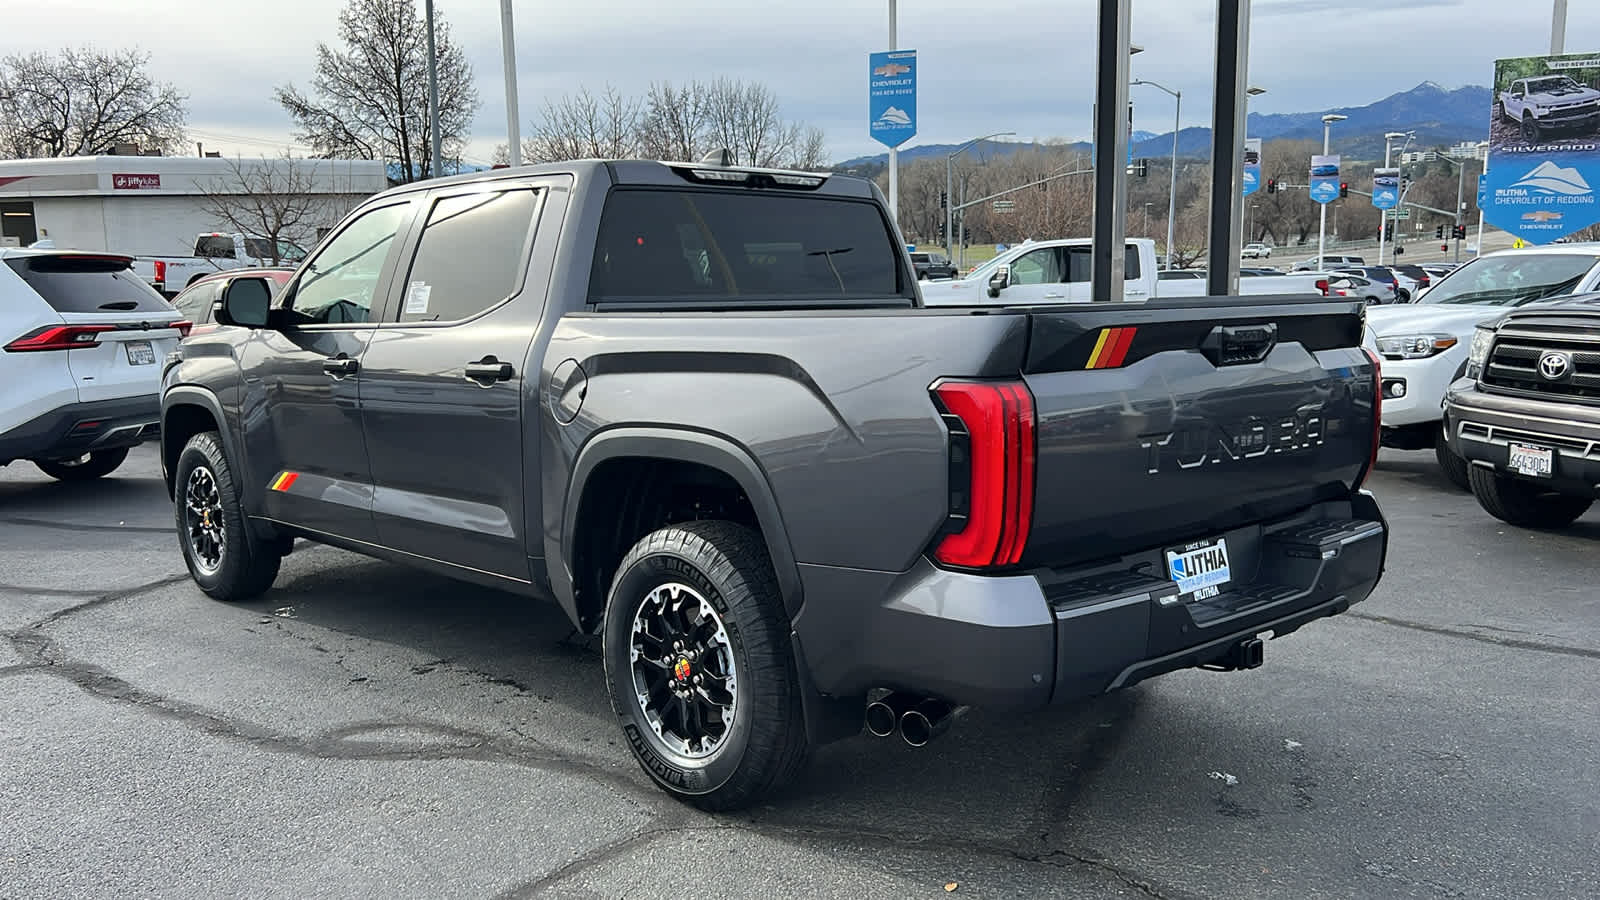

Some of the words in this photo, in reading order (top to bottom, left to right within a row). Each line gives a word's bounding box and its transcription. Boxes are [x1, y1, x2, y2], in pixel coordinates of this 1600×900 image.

[872, 79, 912, 87] CHEVROLET
[1502, 143, 1596, 153] SILVERADO
[1495, 196, 1542, 205] CHEVROLET
[1544, 196, 1555, 204] OF
[1557, 195, 1594, 204] REDDING
[1137, 405, 1324, 474] TUNDRA
[1185, 542, 1199, 551] SINCE
[1184, 548, 1227, 577] LITHIA
[666, 559, 727, 613] MICHELIN
[1201, 585, 1220, 600] LITHIA
[627, 728, 682, 784] MICHELIN
